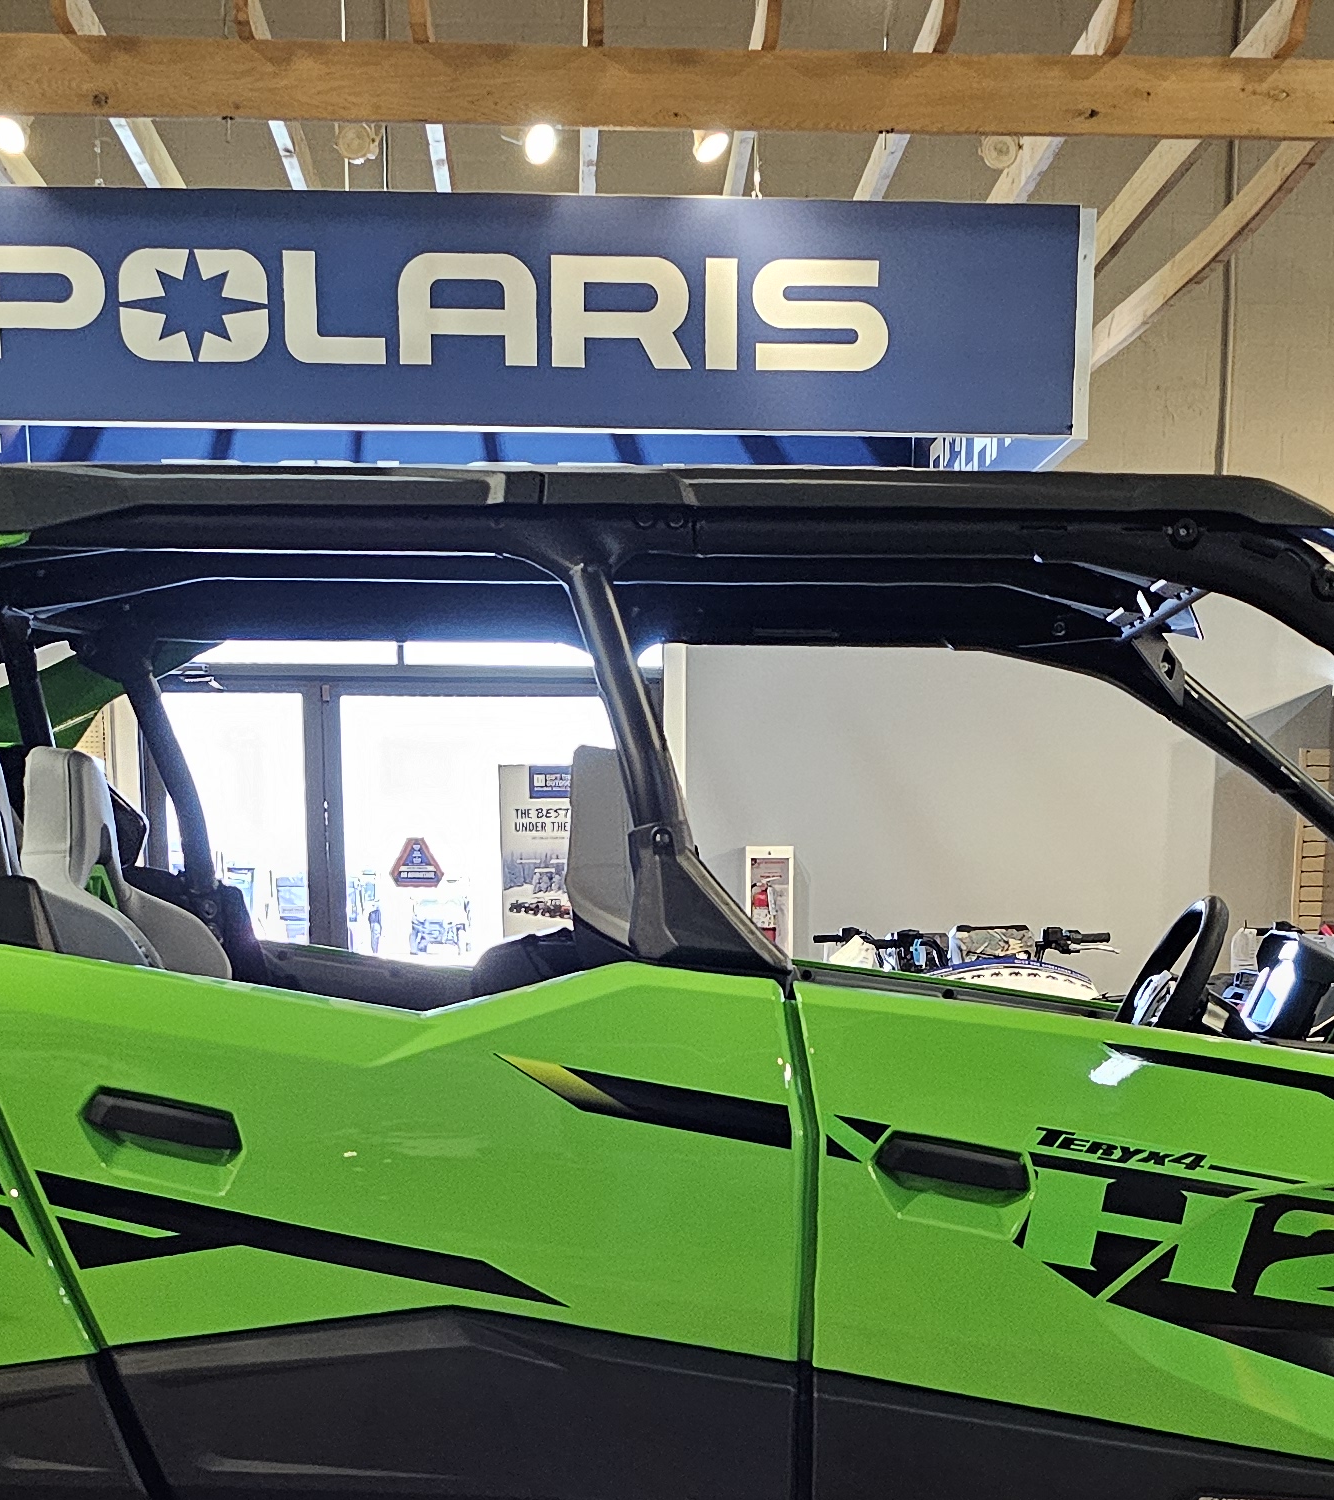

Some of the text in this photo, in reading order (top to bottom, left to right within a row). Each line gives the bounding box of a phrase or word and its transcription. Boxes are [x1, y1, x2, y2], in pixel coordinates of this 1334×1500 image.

[514, 808, 570, 819] THE BEST
[514, 821, 569, 832] UNDER THE
